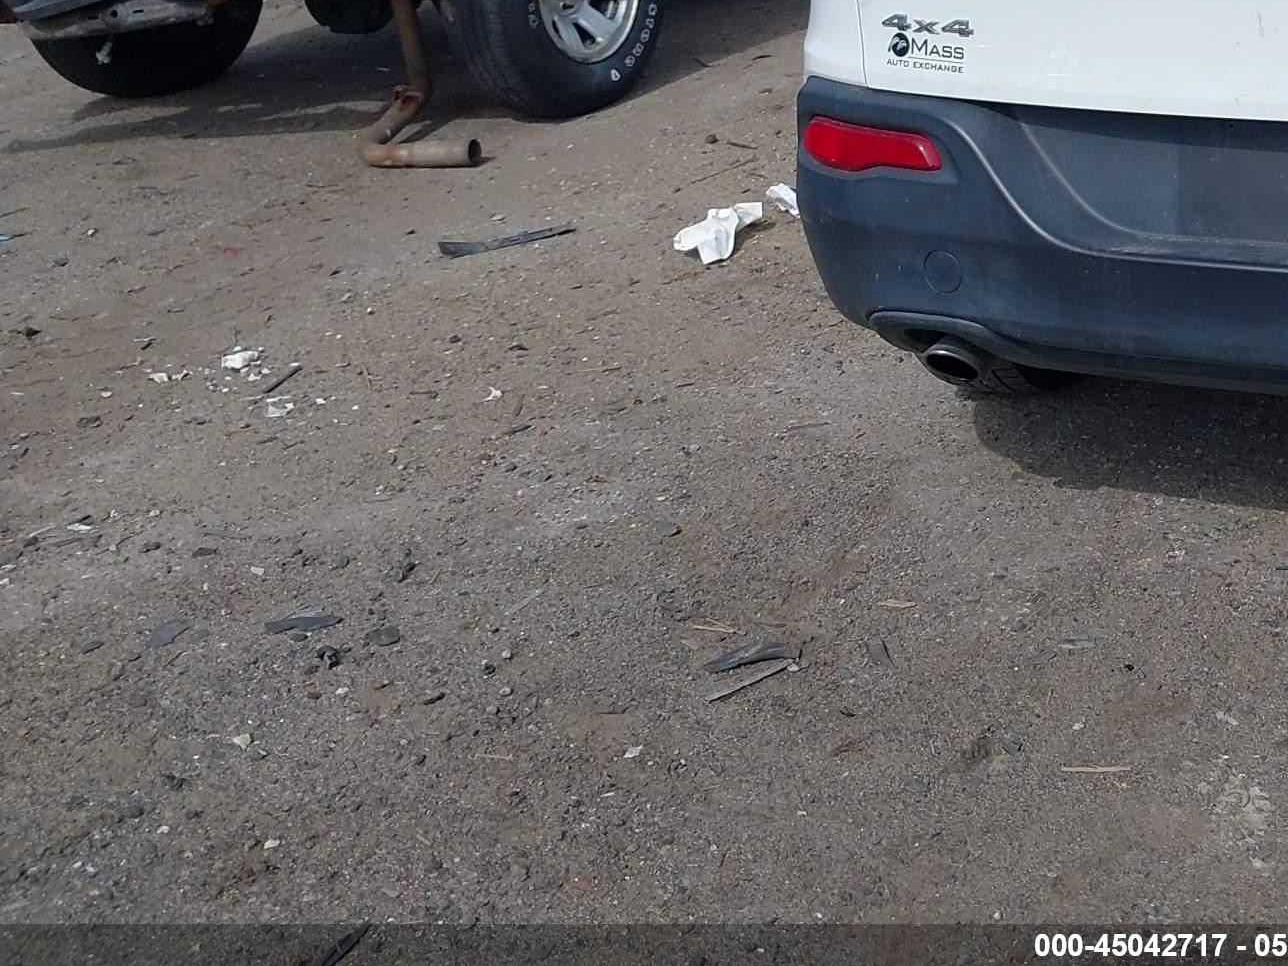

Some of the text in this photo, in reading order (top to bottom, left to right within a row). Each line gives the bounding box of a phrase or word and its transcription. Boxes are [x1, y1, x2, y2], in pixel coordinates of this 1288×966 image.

[881, 13, 975, 38] 4x4
[886, 58, 965, 74] AUTO EXCHANGE
